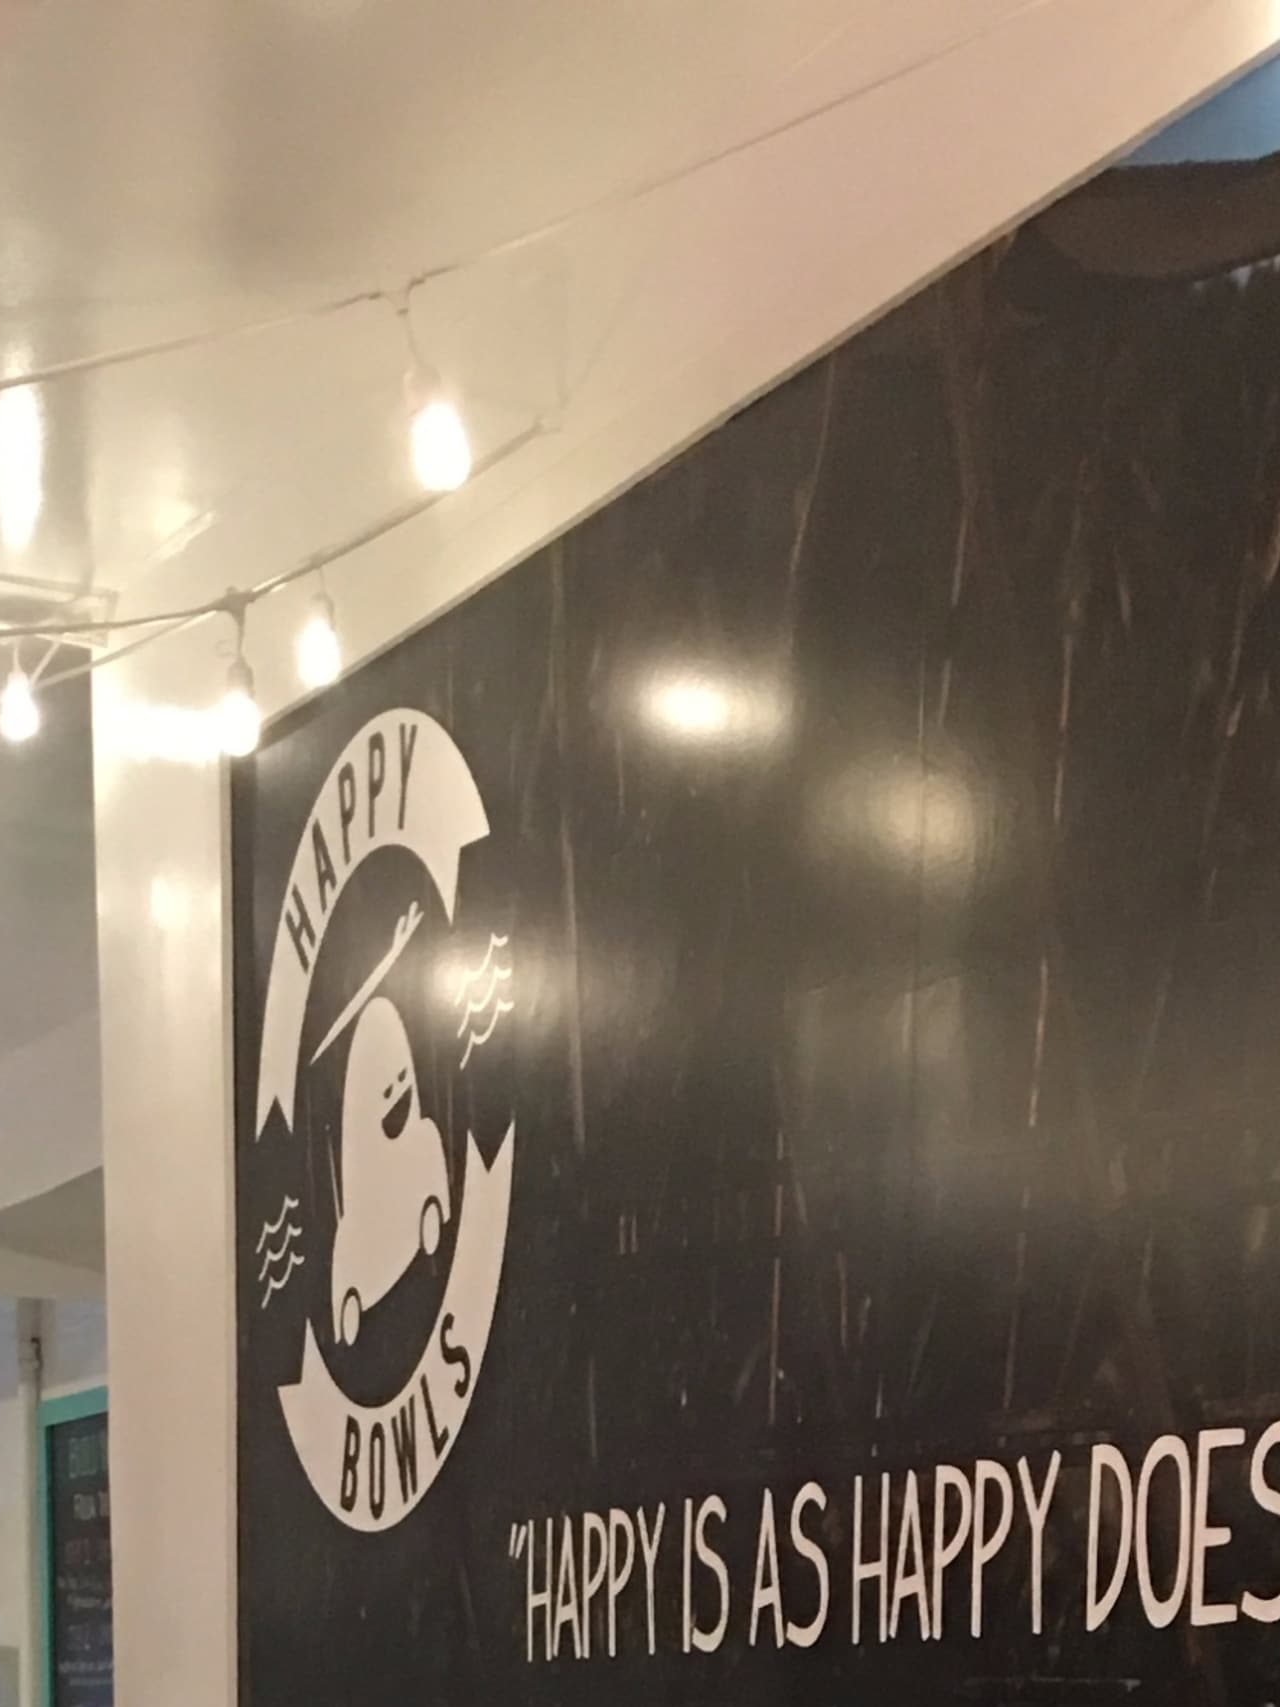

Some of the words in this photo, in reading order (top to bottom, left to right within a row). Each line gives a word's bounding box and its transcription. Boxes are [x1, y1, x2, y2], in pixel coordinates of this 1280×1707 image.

[285, 722, 418, 974] HAPPY
[340, 1312, 472, 1520] BOWLS
[682, 1494, 730, 1653] IS
[748, 1481, 830, 1648] AS
[851, 1449, 1062, 1645] HAPPY
